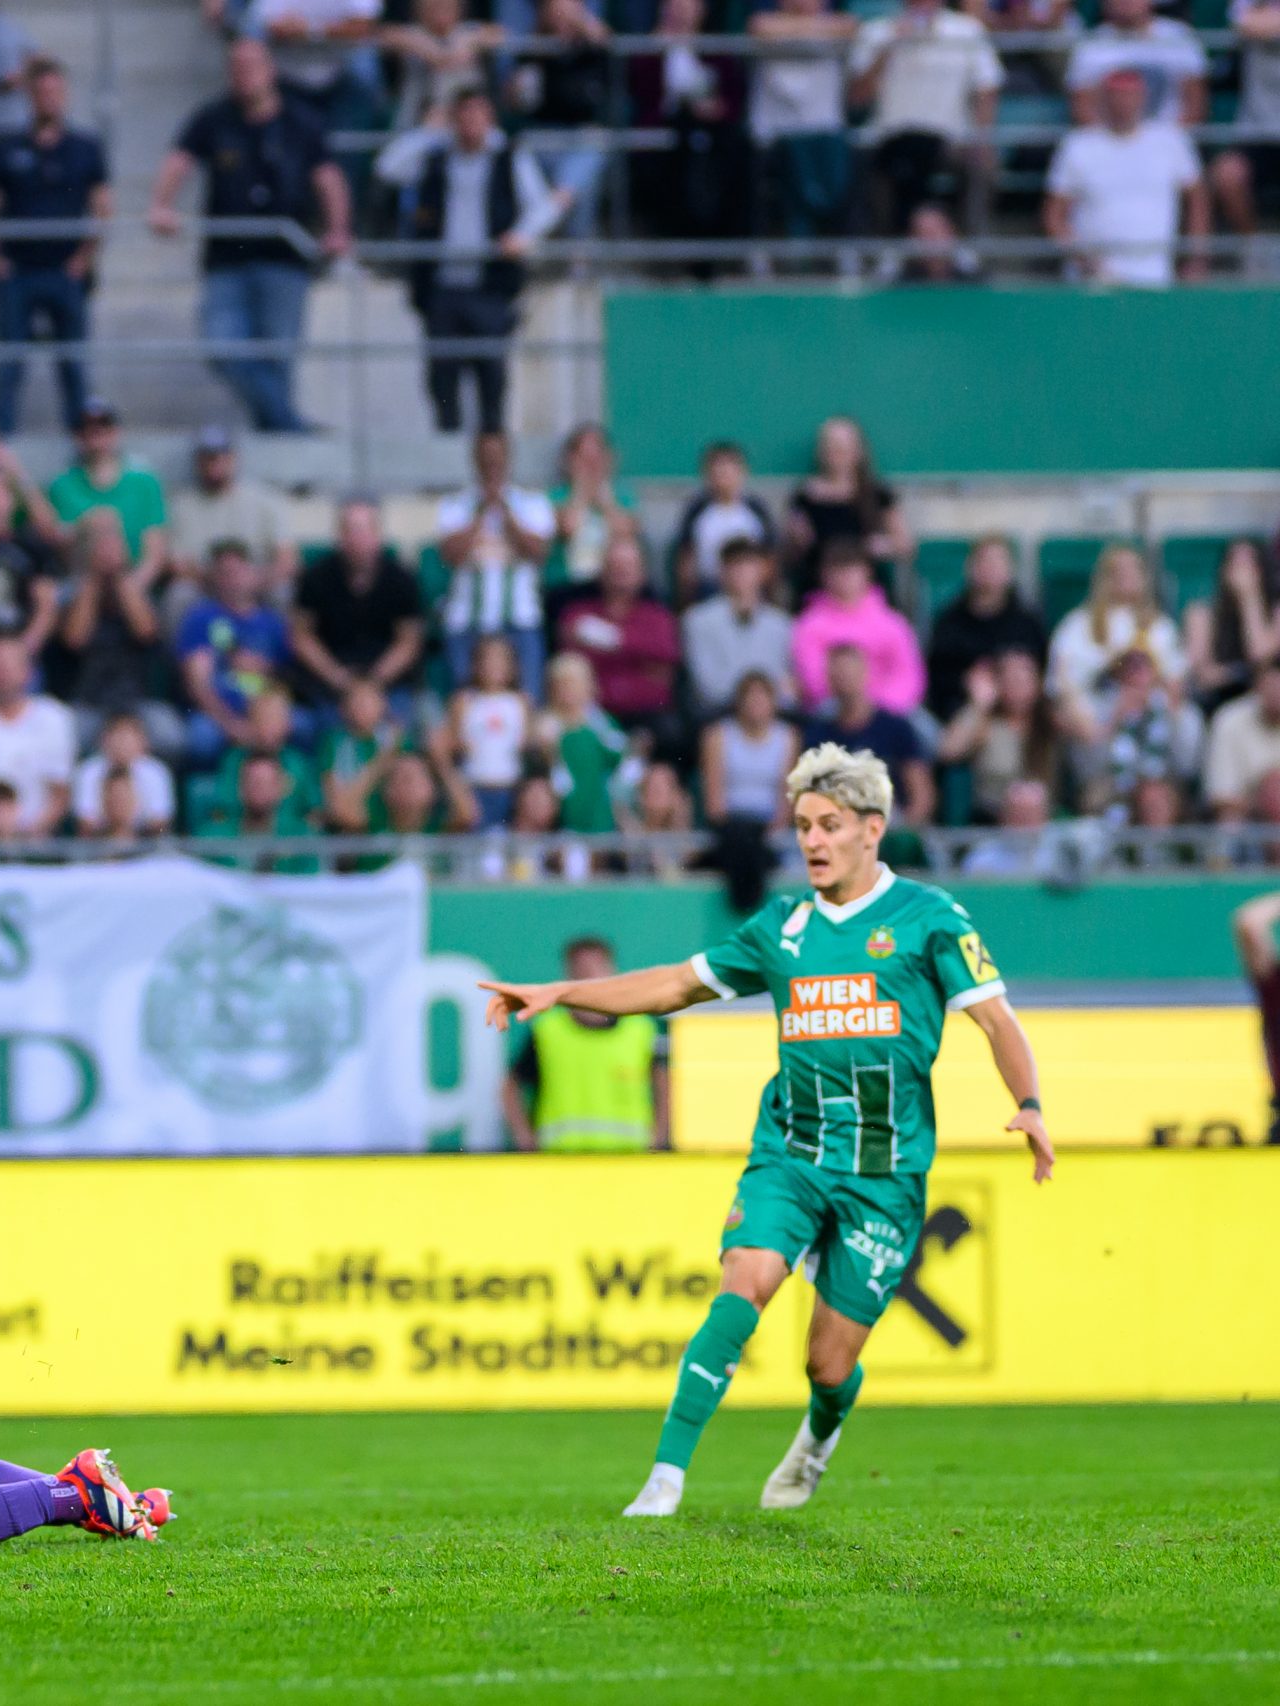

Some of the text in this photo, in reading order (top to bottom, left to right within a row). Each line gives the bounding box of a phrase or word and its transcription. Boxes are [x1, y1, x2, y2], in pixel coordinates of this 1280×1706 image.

[794, 978, 873, 1006] WIEN
[782, 1006, 895, 1036] ENERGIE
[229, 1251, 721, 1305] Raiffeisen Wie
[175, 1320, 754, 1374] Meine Stadtba
